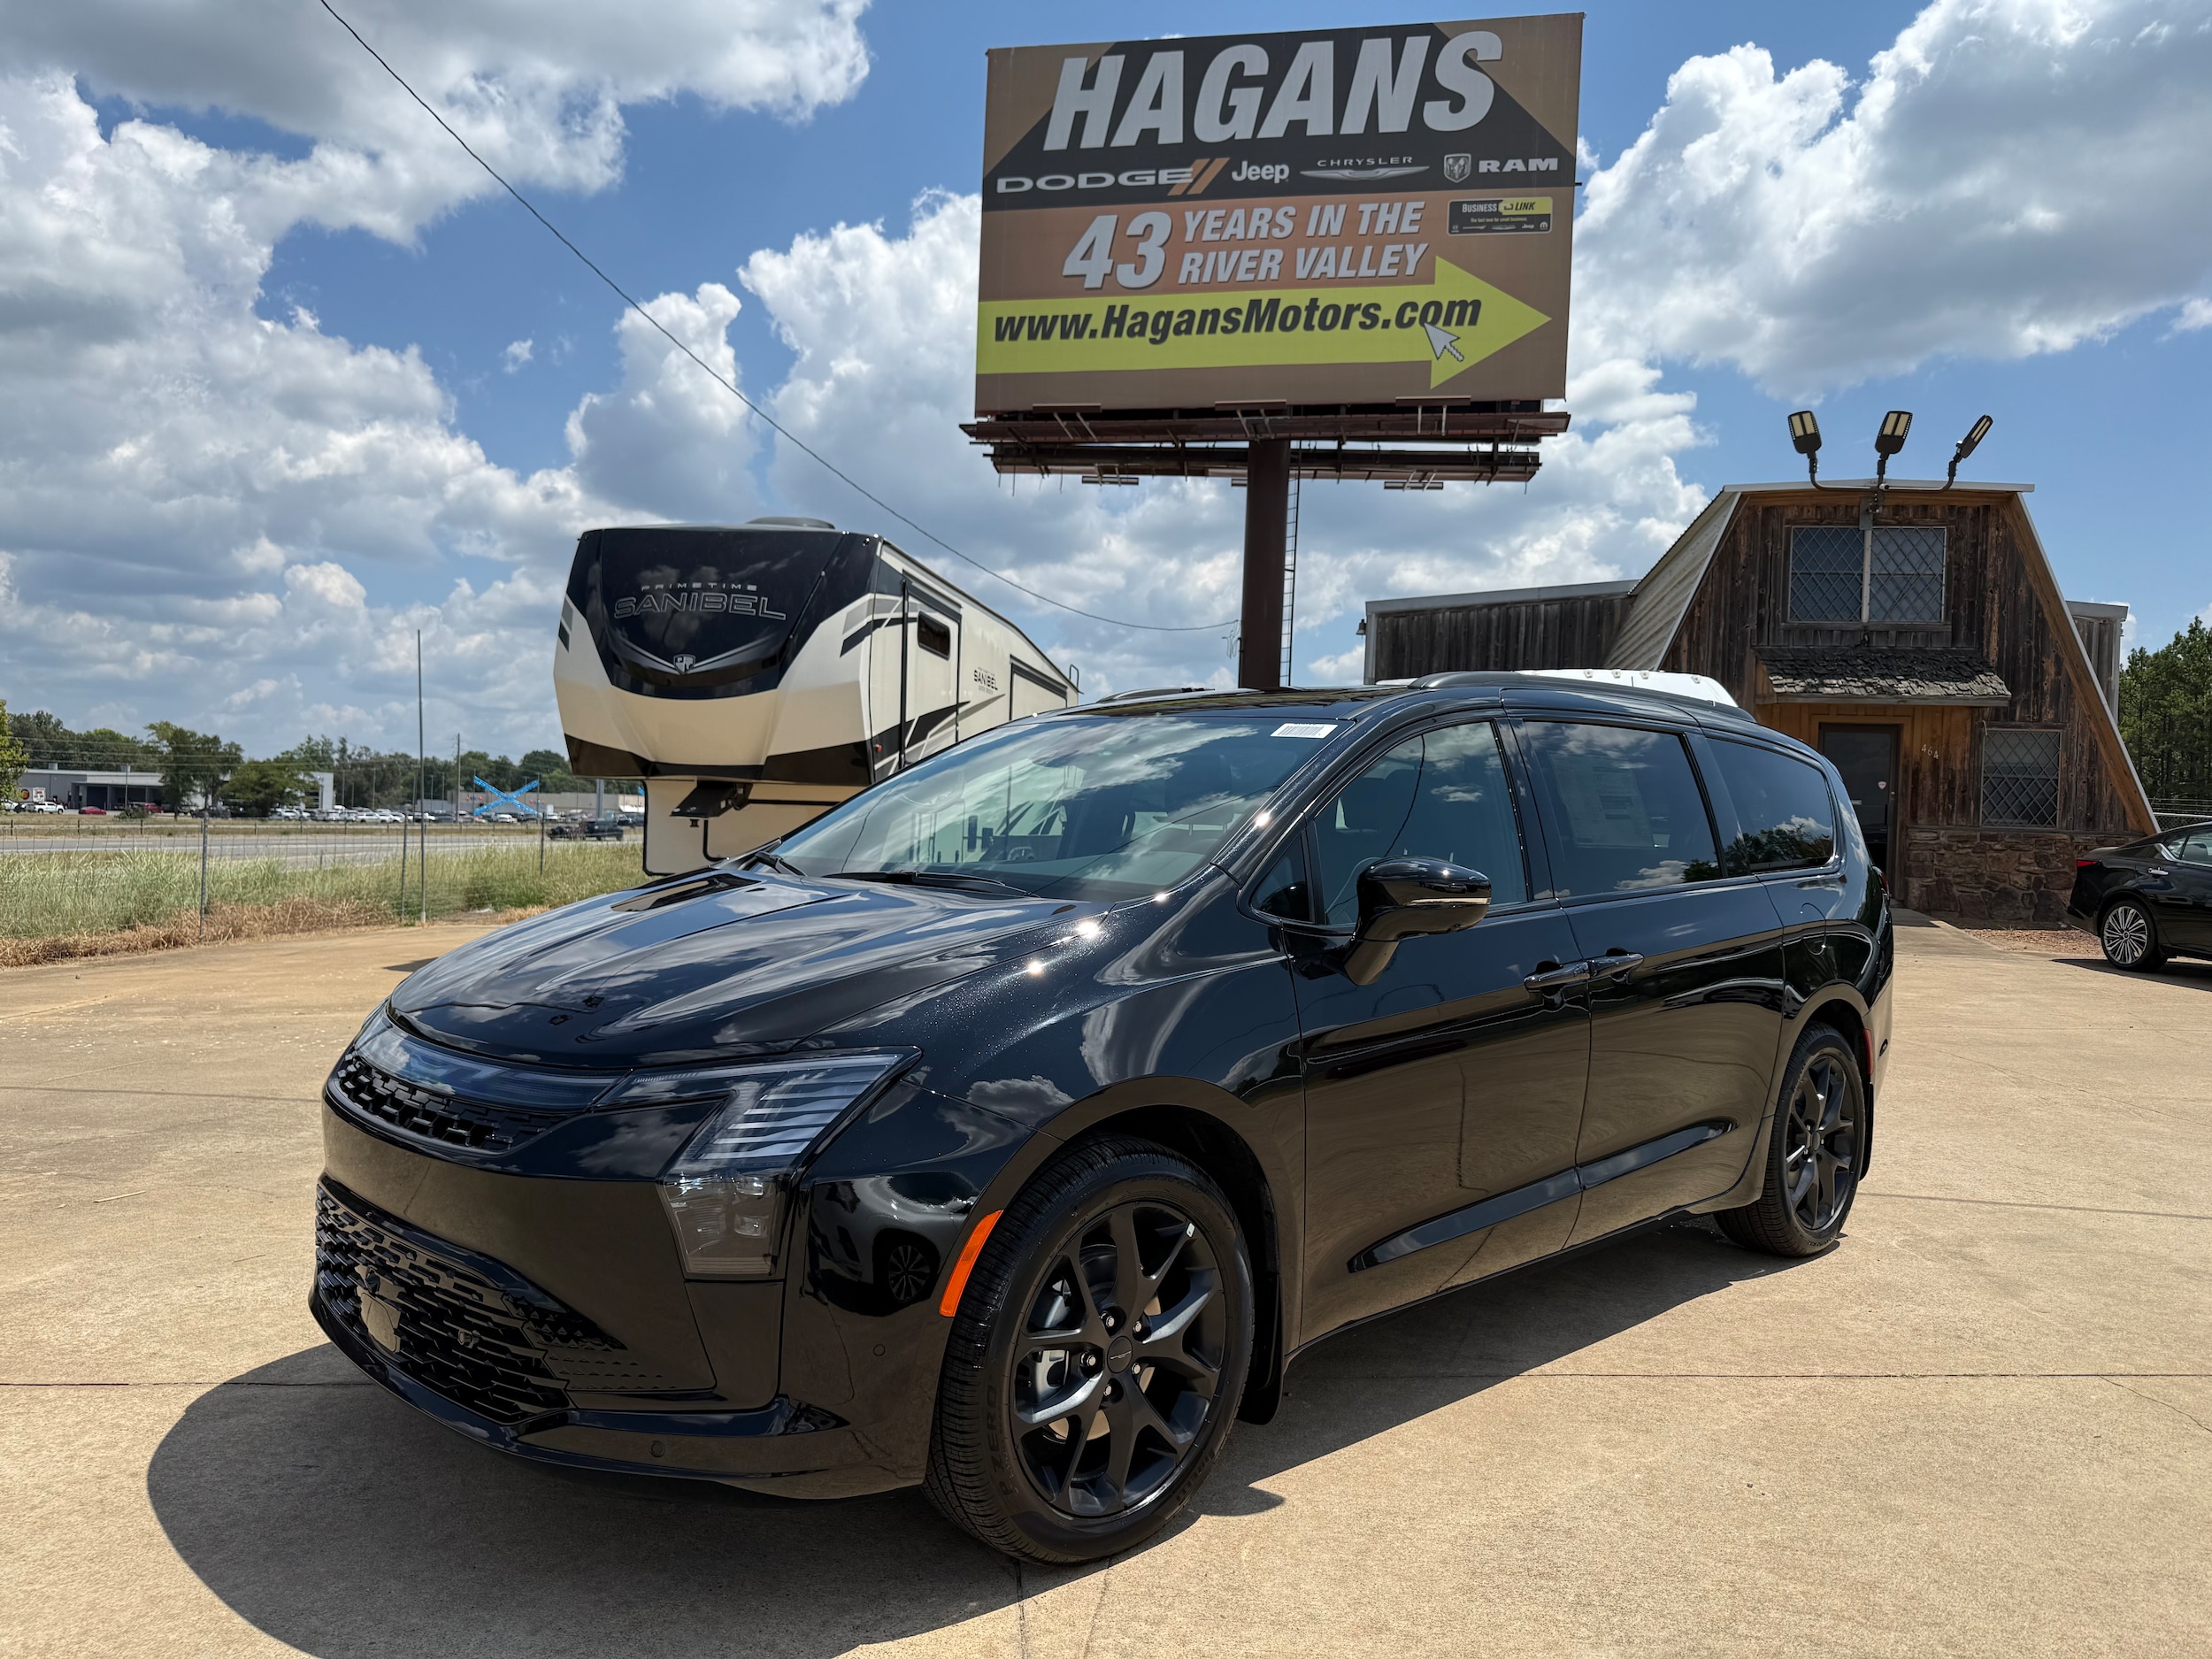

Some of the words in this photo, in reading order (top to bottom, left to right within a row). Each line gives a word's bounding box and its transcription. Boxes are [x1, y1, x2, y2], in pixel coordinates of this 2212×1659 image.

[1043, 31, 1502, 151] HAGANS
[1231, 160, 1290, 183] Jeep
[1317, 156, 1414, 167] CHRYSLER
[1479, 157, 1558, 173] RAM
[996, 167, 1194, 193] DODGE
[1514, 202, 1536, 211] LINK
[1184, 205, 1297, 243] YEARS
[1305, 204, 1347, 237] IN
[1358, 201, 1425, 236] THE
[1062, 211, 1172, 290] 43
[1178, 249, 1284, 285] RIVER
[1295, 242, 1429, 280] VALLEY
[995, 297, 1482, 345] www.HagansMotors.com
[641, 581, 758, 592] PRIMETIME
[613, 591, 787, 621] SANIBEL
[1921, 743, 1939, 760] 464
